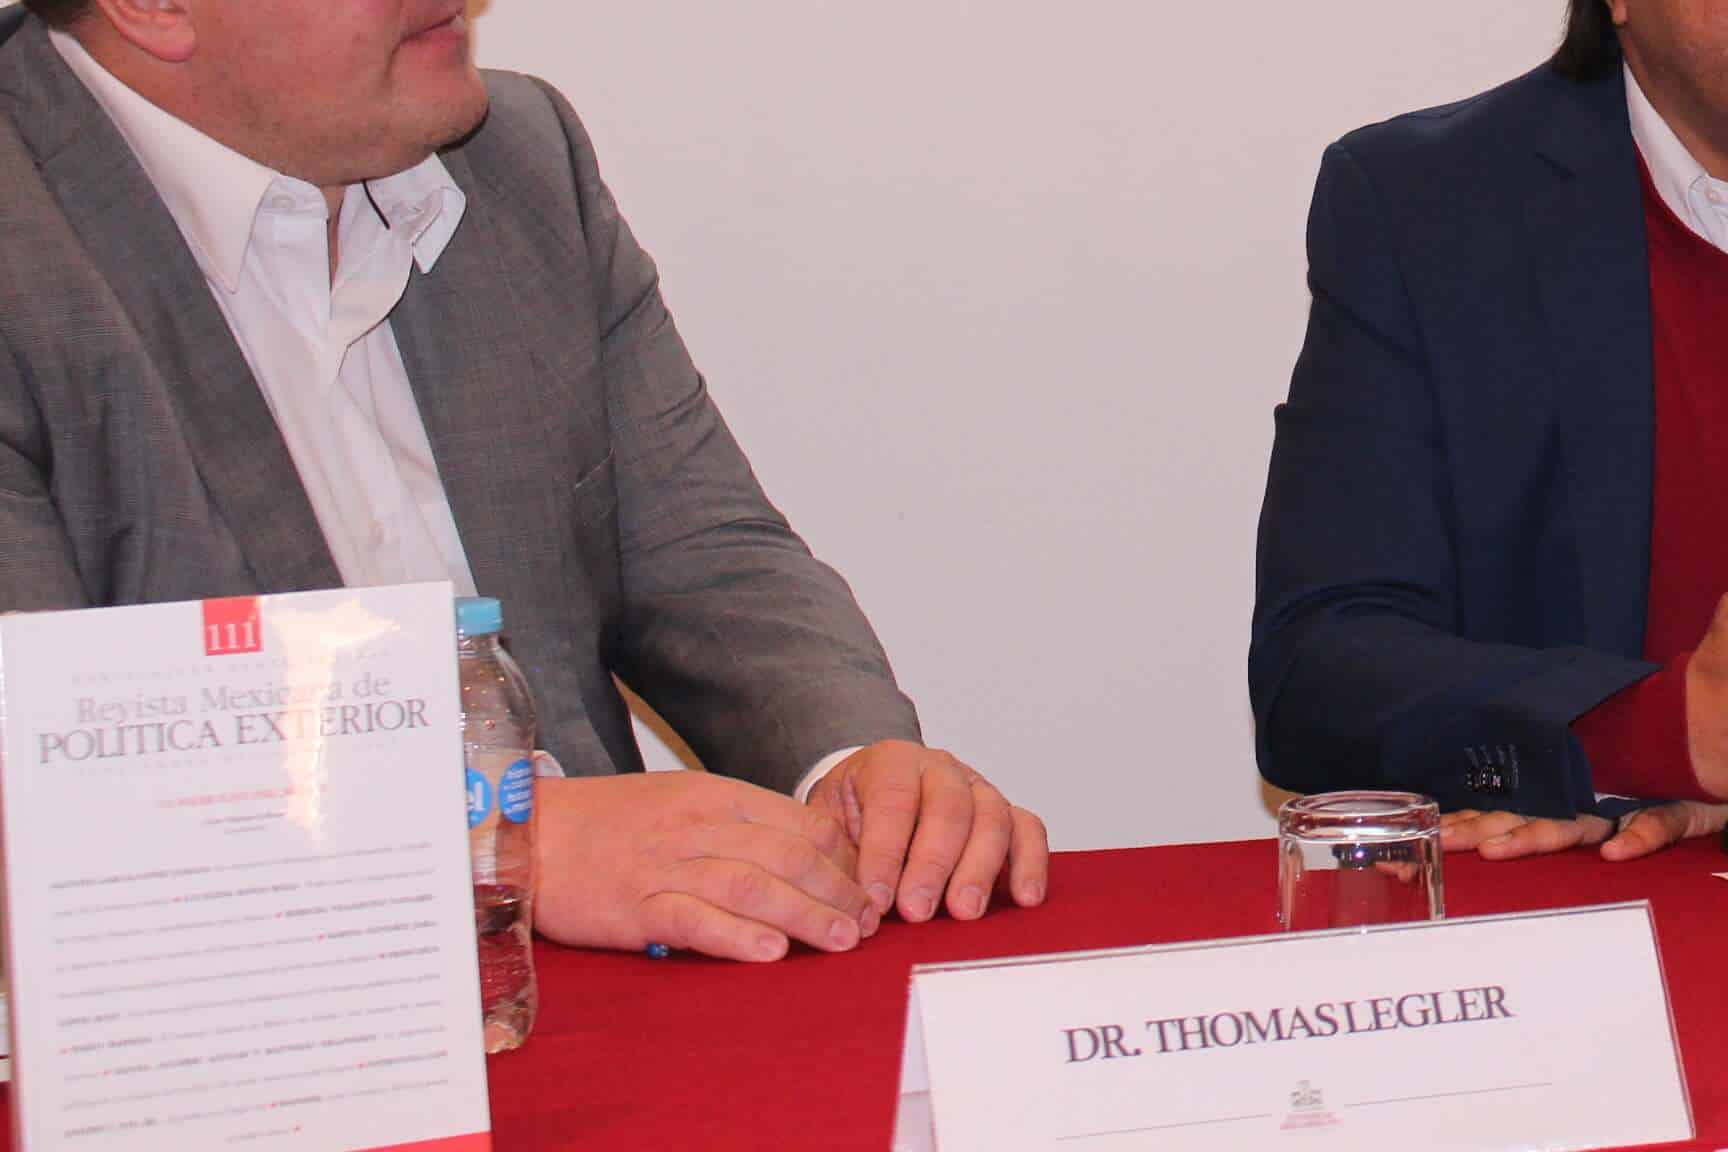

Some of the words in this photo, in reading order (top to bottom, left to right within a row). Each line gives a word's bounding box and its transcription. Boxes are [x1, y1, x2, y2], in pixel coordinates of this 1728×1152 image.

[206, 620, 260, 651] 111
[74, 688, 188, 730] Revista
[202, 680, 344, 714] Mexica
[351, 671, 391, 699] de
[38, 719, 223, 765] POLÍTICA
[1061, 1023, 1142, 1063] DR.
[1145, 1001, 1340, 1054] THOMAS
[1338, 985, 1513, 1034] LEGLER
